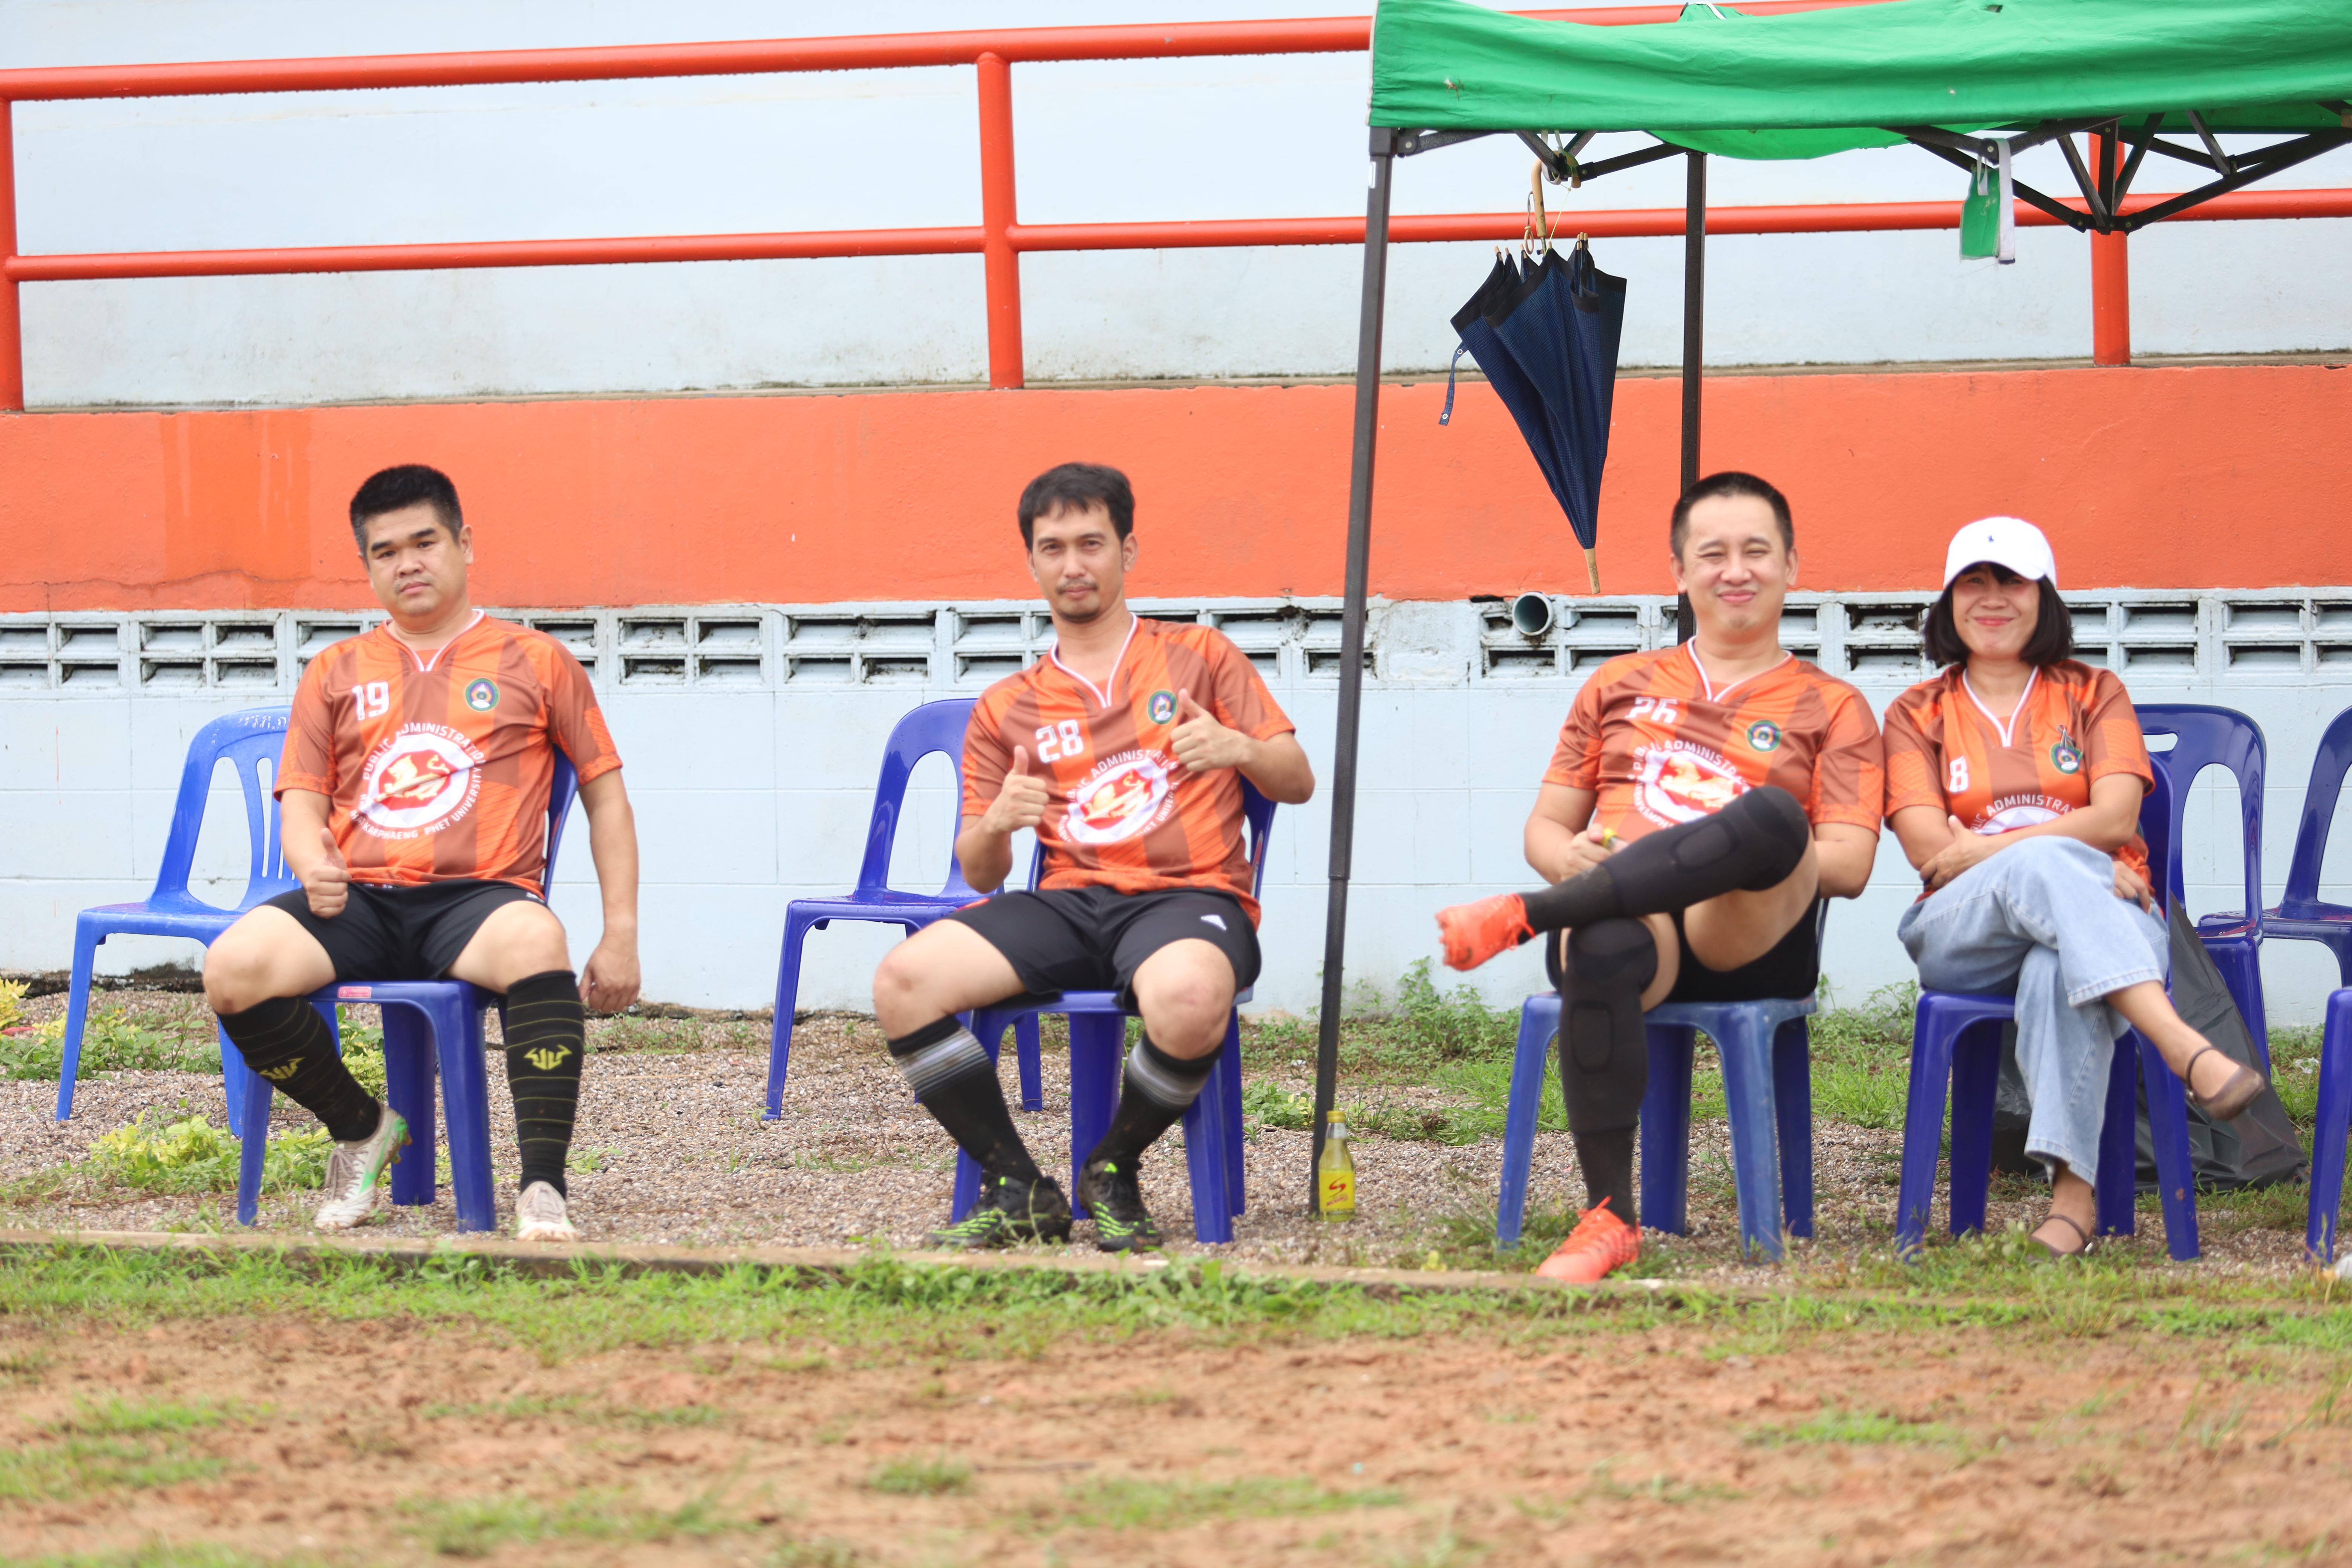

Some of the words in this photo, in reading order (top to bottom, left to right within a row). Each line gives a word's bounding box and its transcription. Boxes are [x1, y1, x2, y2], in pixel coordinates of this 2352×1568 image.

[352, 681, 389, 720] 19
[363, 738, 392, 780] PUBLIC
[1035, 719, 1083, 763] 28
[1091, 749, 1178, 778] ADMINISTATIN
[1949, 755, 1968, 793] 8
[424, 819, 451, 835] PHET
[452, 767, 482, 822] UNIVERSITY
[1155, 782, 1179, 821] UNIVERSI
[1970, 813, 1986, 833] BLIC
[1986, 794, 2075, 817] ADMINISTRA
